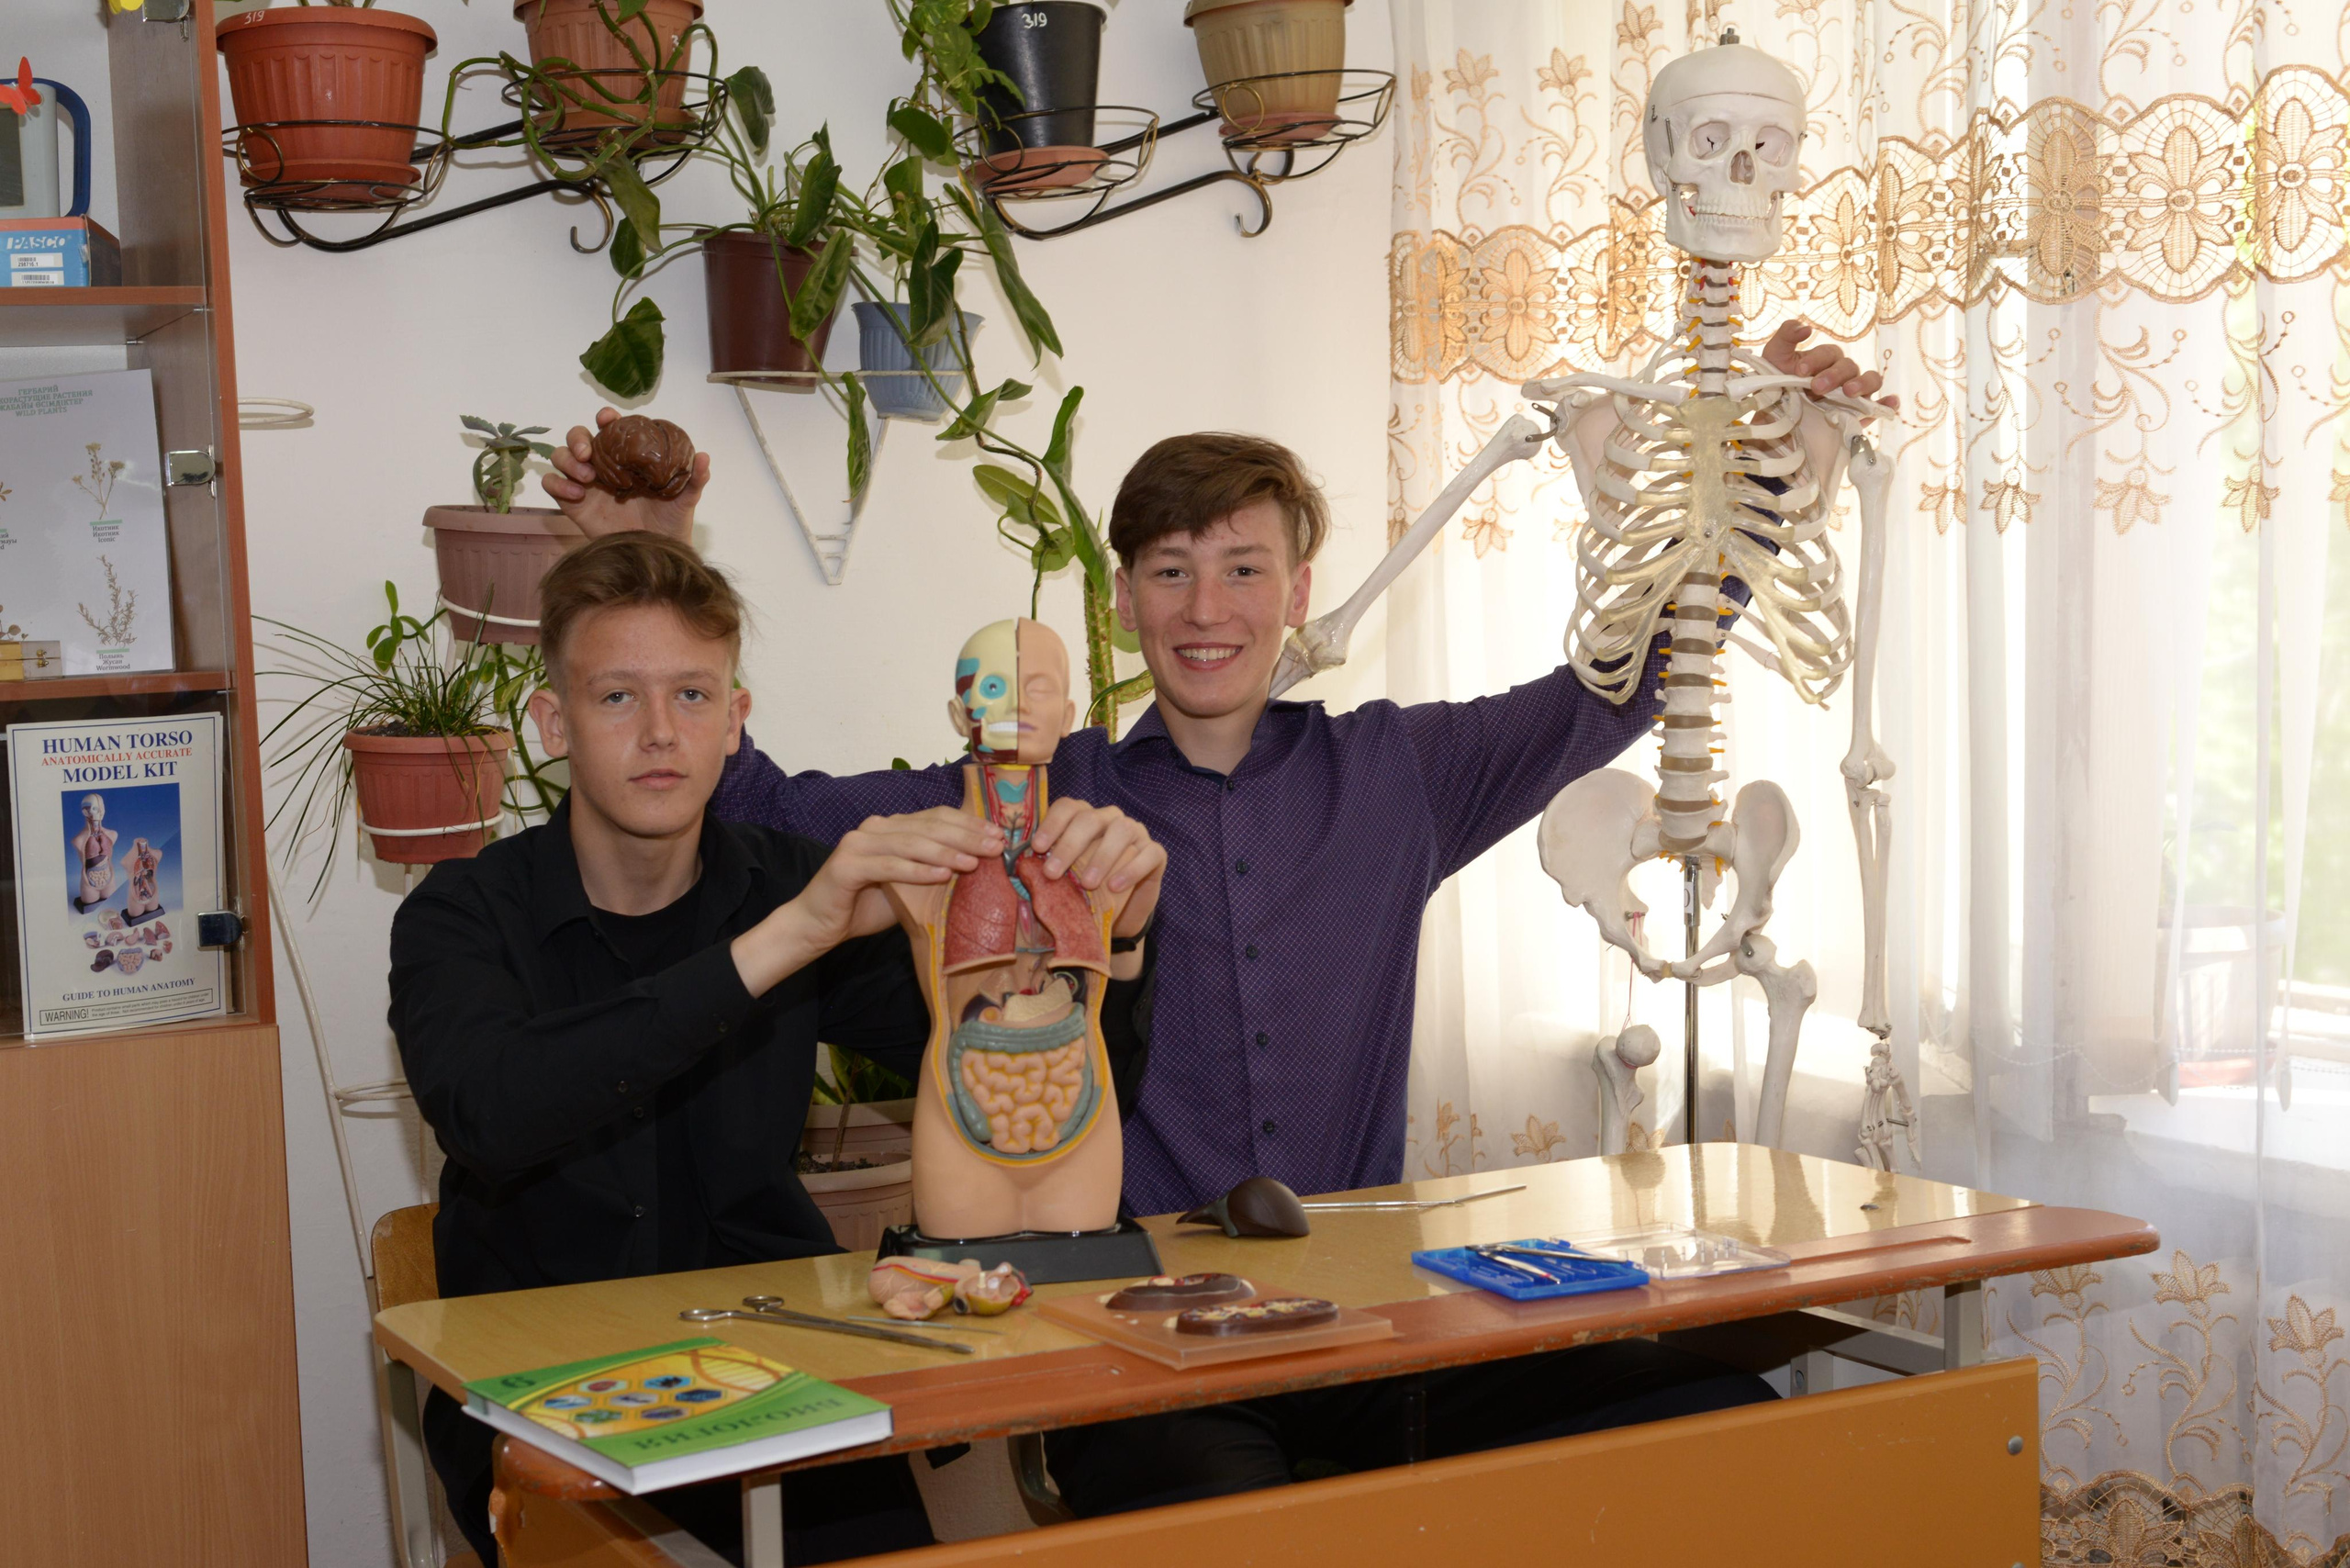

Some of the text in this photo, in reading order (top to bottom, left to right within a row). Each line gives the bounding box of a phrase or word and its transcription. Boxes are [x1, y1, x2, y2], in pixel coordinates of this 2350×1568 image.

[244, 10, 265, 25] 319
[1022, 12, 1048, 28] 319
[6, 236, 66, 250] PASCO
[18, 385, 59, 396] ГЕРБАРИЙ
[53, 390, 93, 400] РАСТЕНИЯ
[16, 407, 67, 417] WILD PLANTS
[42, 730, 193, 754] HUMAN TORSO
[41, 747, 192, 766] ANATOMICALLY ACCURATE
[62, 761, 177, 783] MODEL KIT
[62, 978, 196, 1002] GUIDE TO HUMAN ANATOMY
[45, 1009, 89, 1023] WARNING!
[633, 1397, 844, 1450] БИОЛОГИЯ
